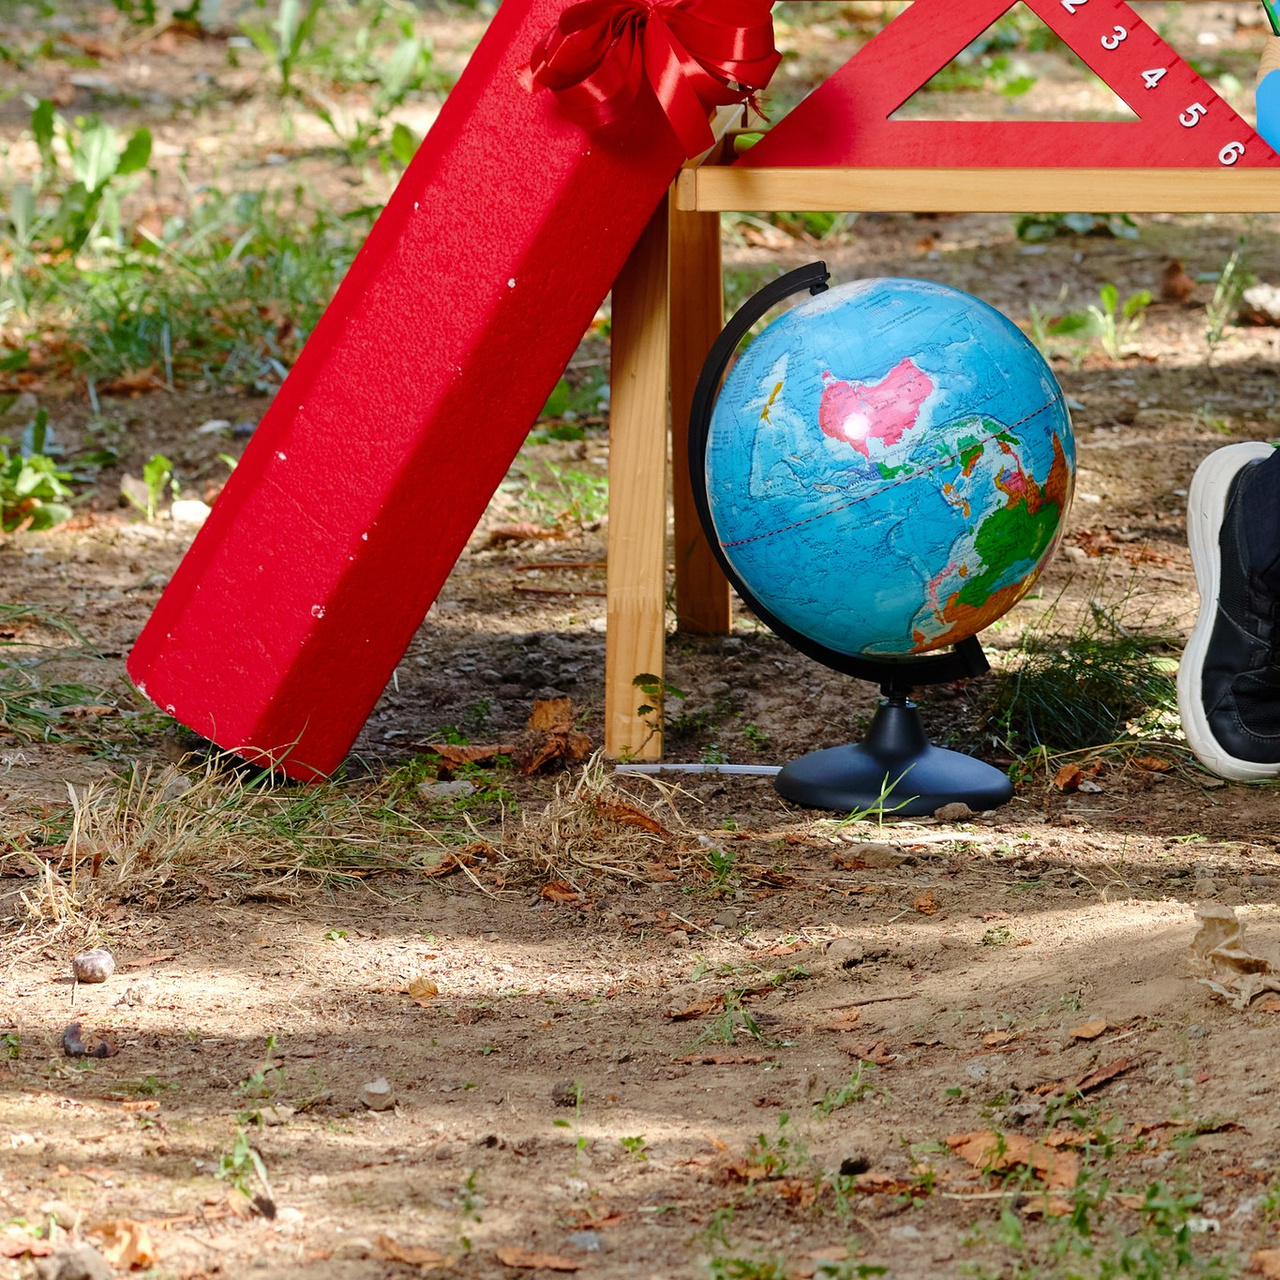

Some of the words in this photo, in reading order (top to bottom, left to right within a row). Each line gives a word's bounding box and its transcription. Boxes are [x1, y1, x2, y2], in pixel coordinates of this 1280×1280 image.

[1100, 25, 1128, 51] 3
[1140, 67, 1168, 90] 4
[1178, 102, 1209, 129] 5
[1217, 140, 1246, 166] 6
